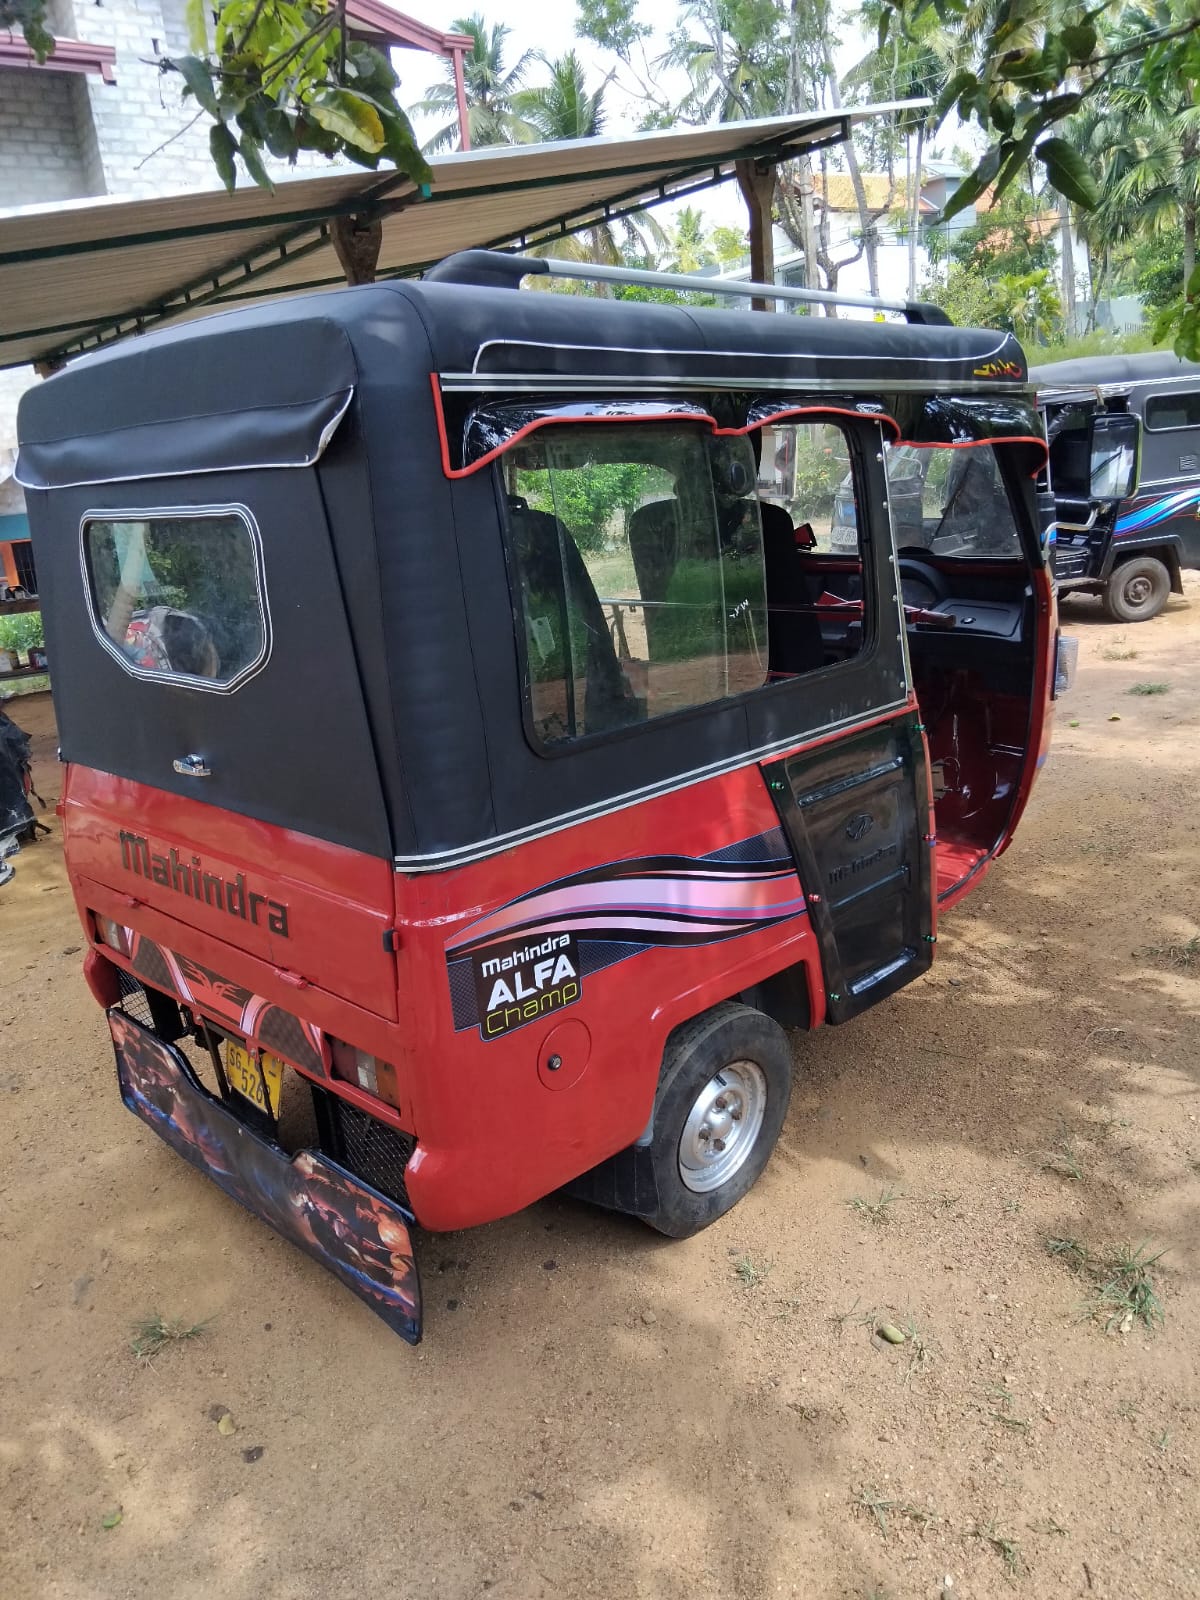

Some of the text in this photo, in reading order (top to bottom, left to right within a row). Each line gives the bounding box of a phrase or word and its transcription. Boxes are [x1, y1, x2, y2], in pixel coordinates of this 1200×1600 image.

[119, 830, 290, 938] Mahindra
[486, 954, 577, 1012] ALFA
[486, 982, 578, 1034] Champ
